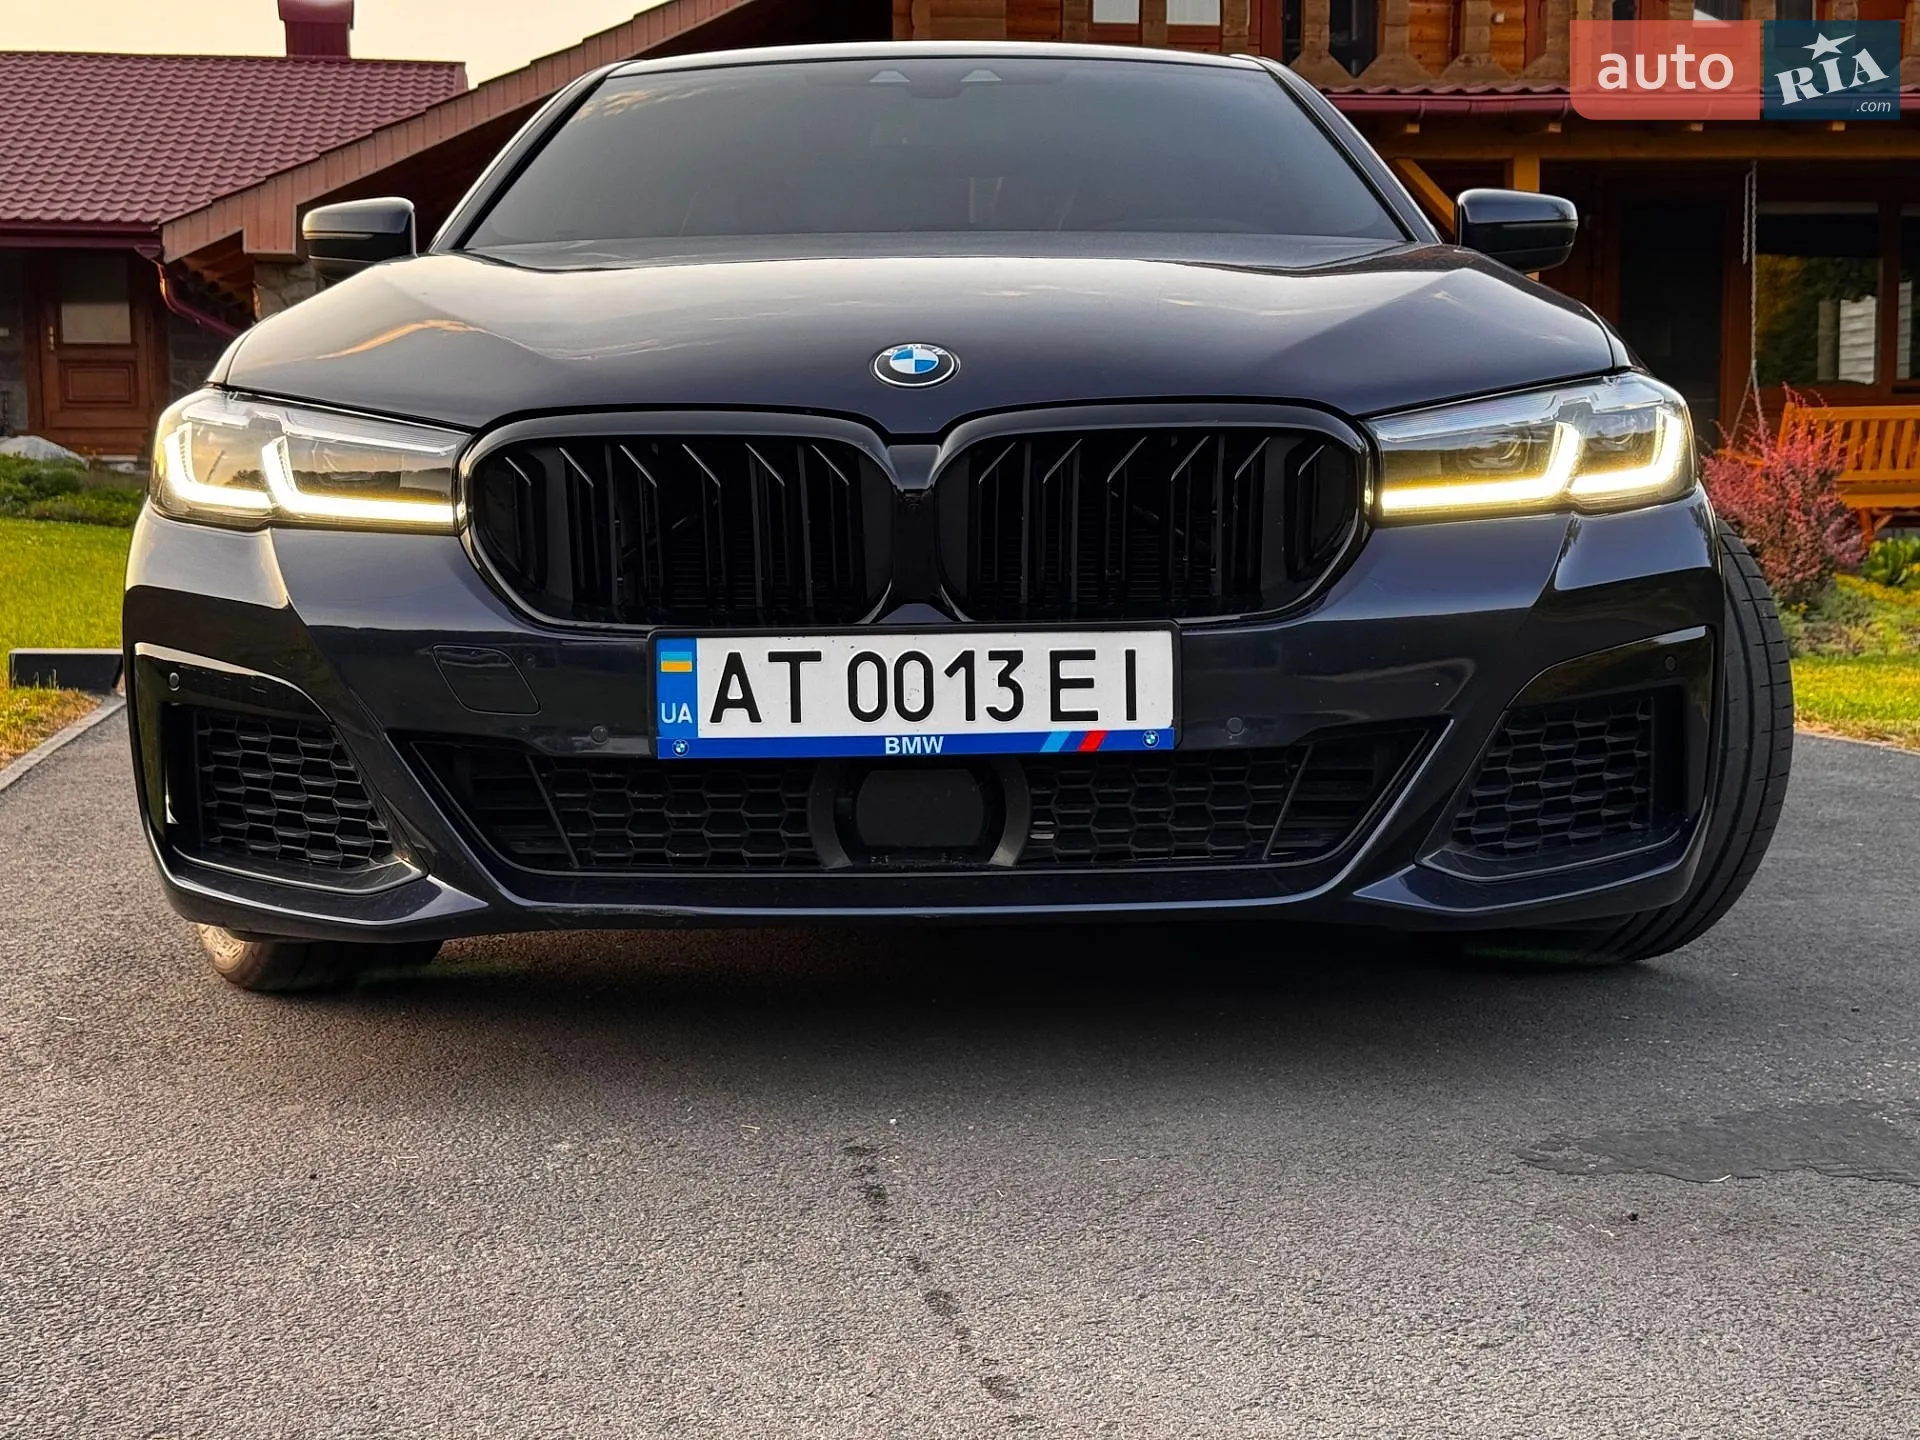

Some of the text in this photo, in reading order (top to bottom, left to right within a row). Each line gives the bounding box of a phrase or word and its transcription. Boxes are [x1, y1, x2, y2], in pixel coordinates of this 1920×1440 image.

[709, 649, 1137, 723] AT 0013 EI
[660, 702, 693, 724] UA
[885, 735, 945, 754] BMW
